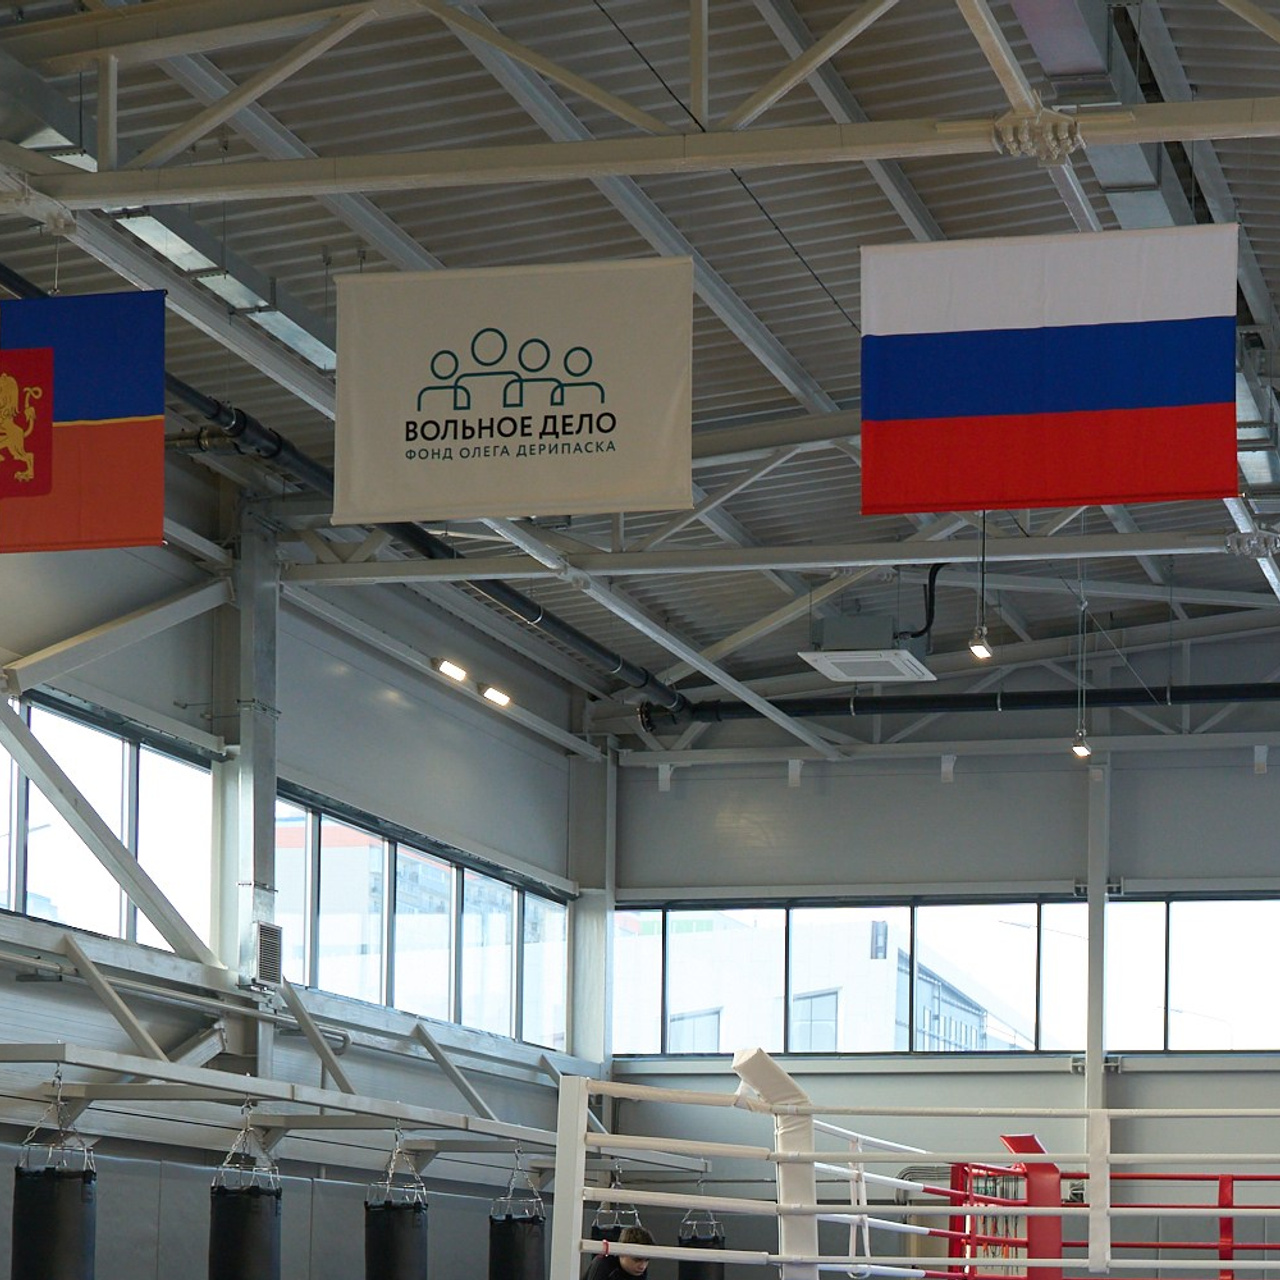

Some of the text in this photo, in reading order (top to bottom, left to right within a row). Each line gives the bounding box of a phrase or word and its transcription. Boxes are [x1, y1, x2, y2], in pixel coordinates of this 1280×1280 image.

[405, 412, 616, 442] ВОЛЬНОЕ ДЕЛО
[405, 441, 616, 460] ФОНД ОЛЕГА ДЕРИПАСКА
